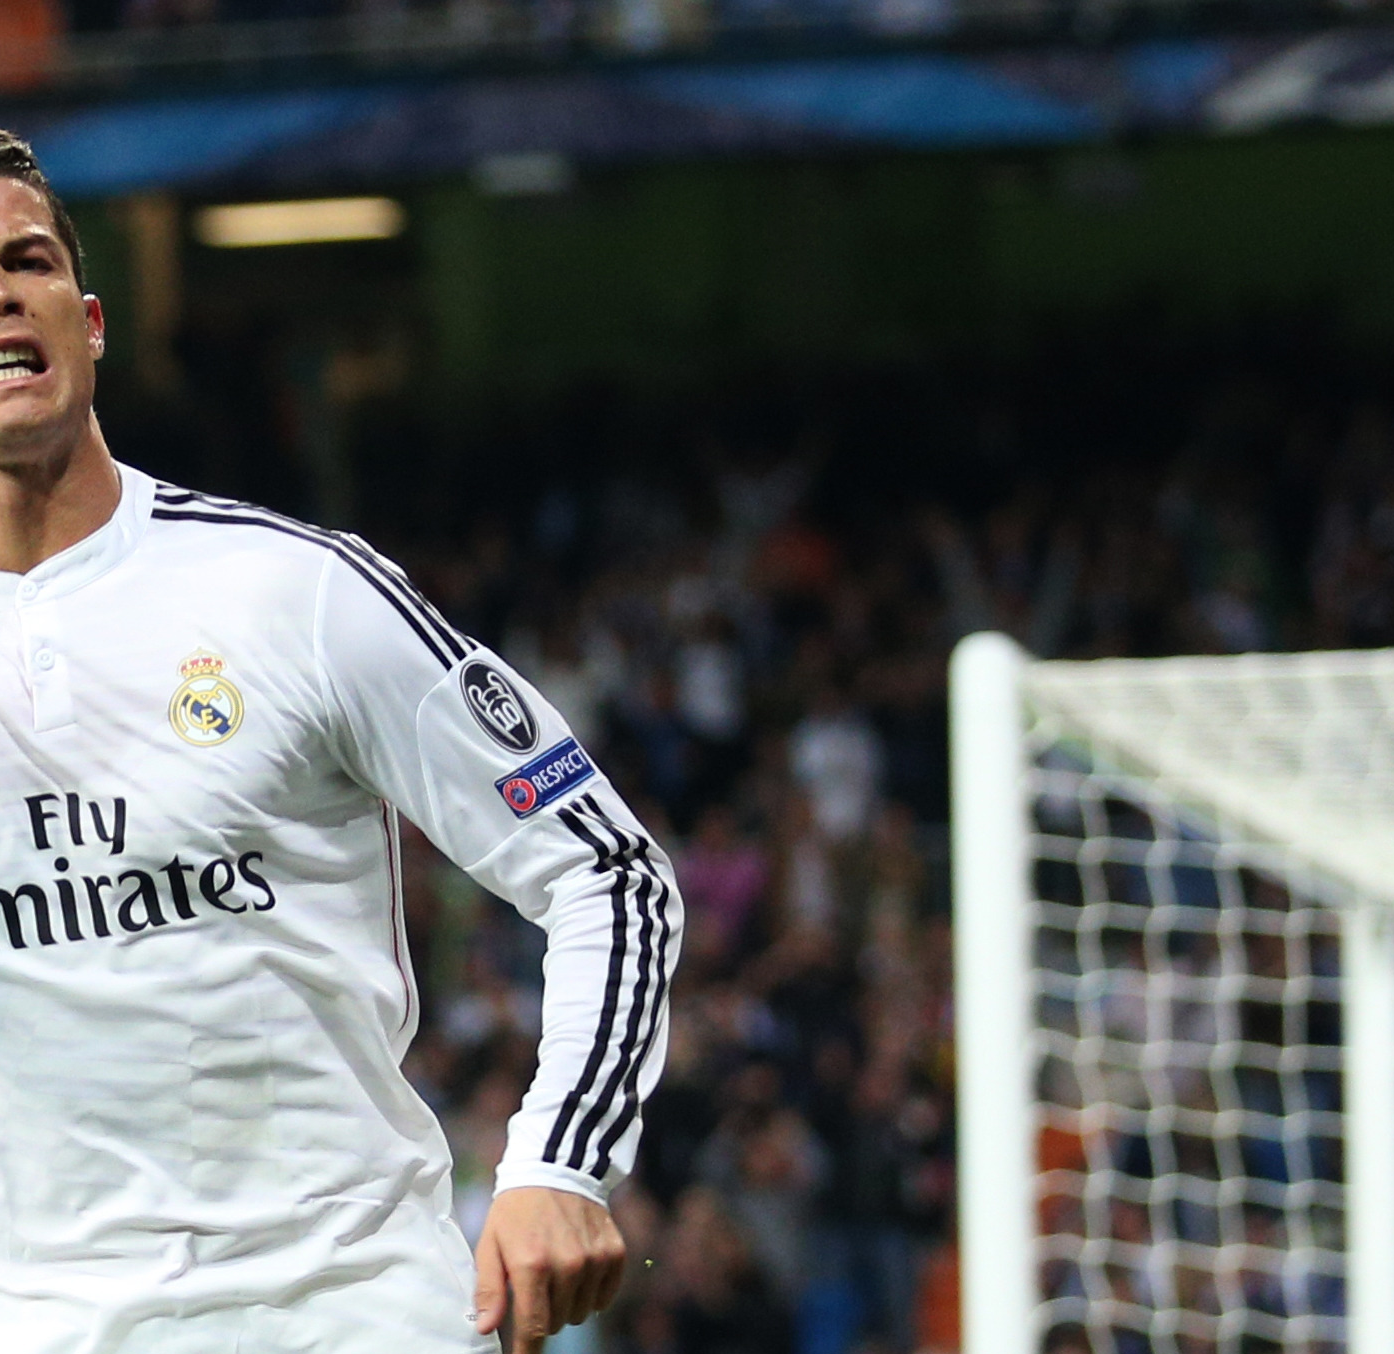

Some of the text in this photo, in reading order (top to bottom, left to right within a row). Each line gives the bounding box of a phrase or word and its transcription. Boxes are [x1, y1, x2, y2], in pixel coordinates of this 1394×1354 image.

[493, 701, 521, 731] 10
[530, 747, 587, 793] RESPECT
[23, 792, 127, 856] Fly
